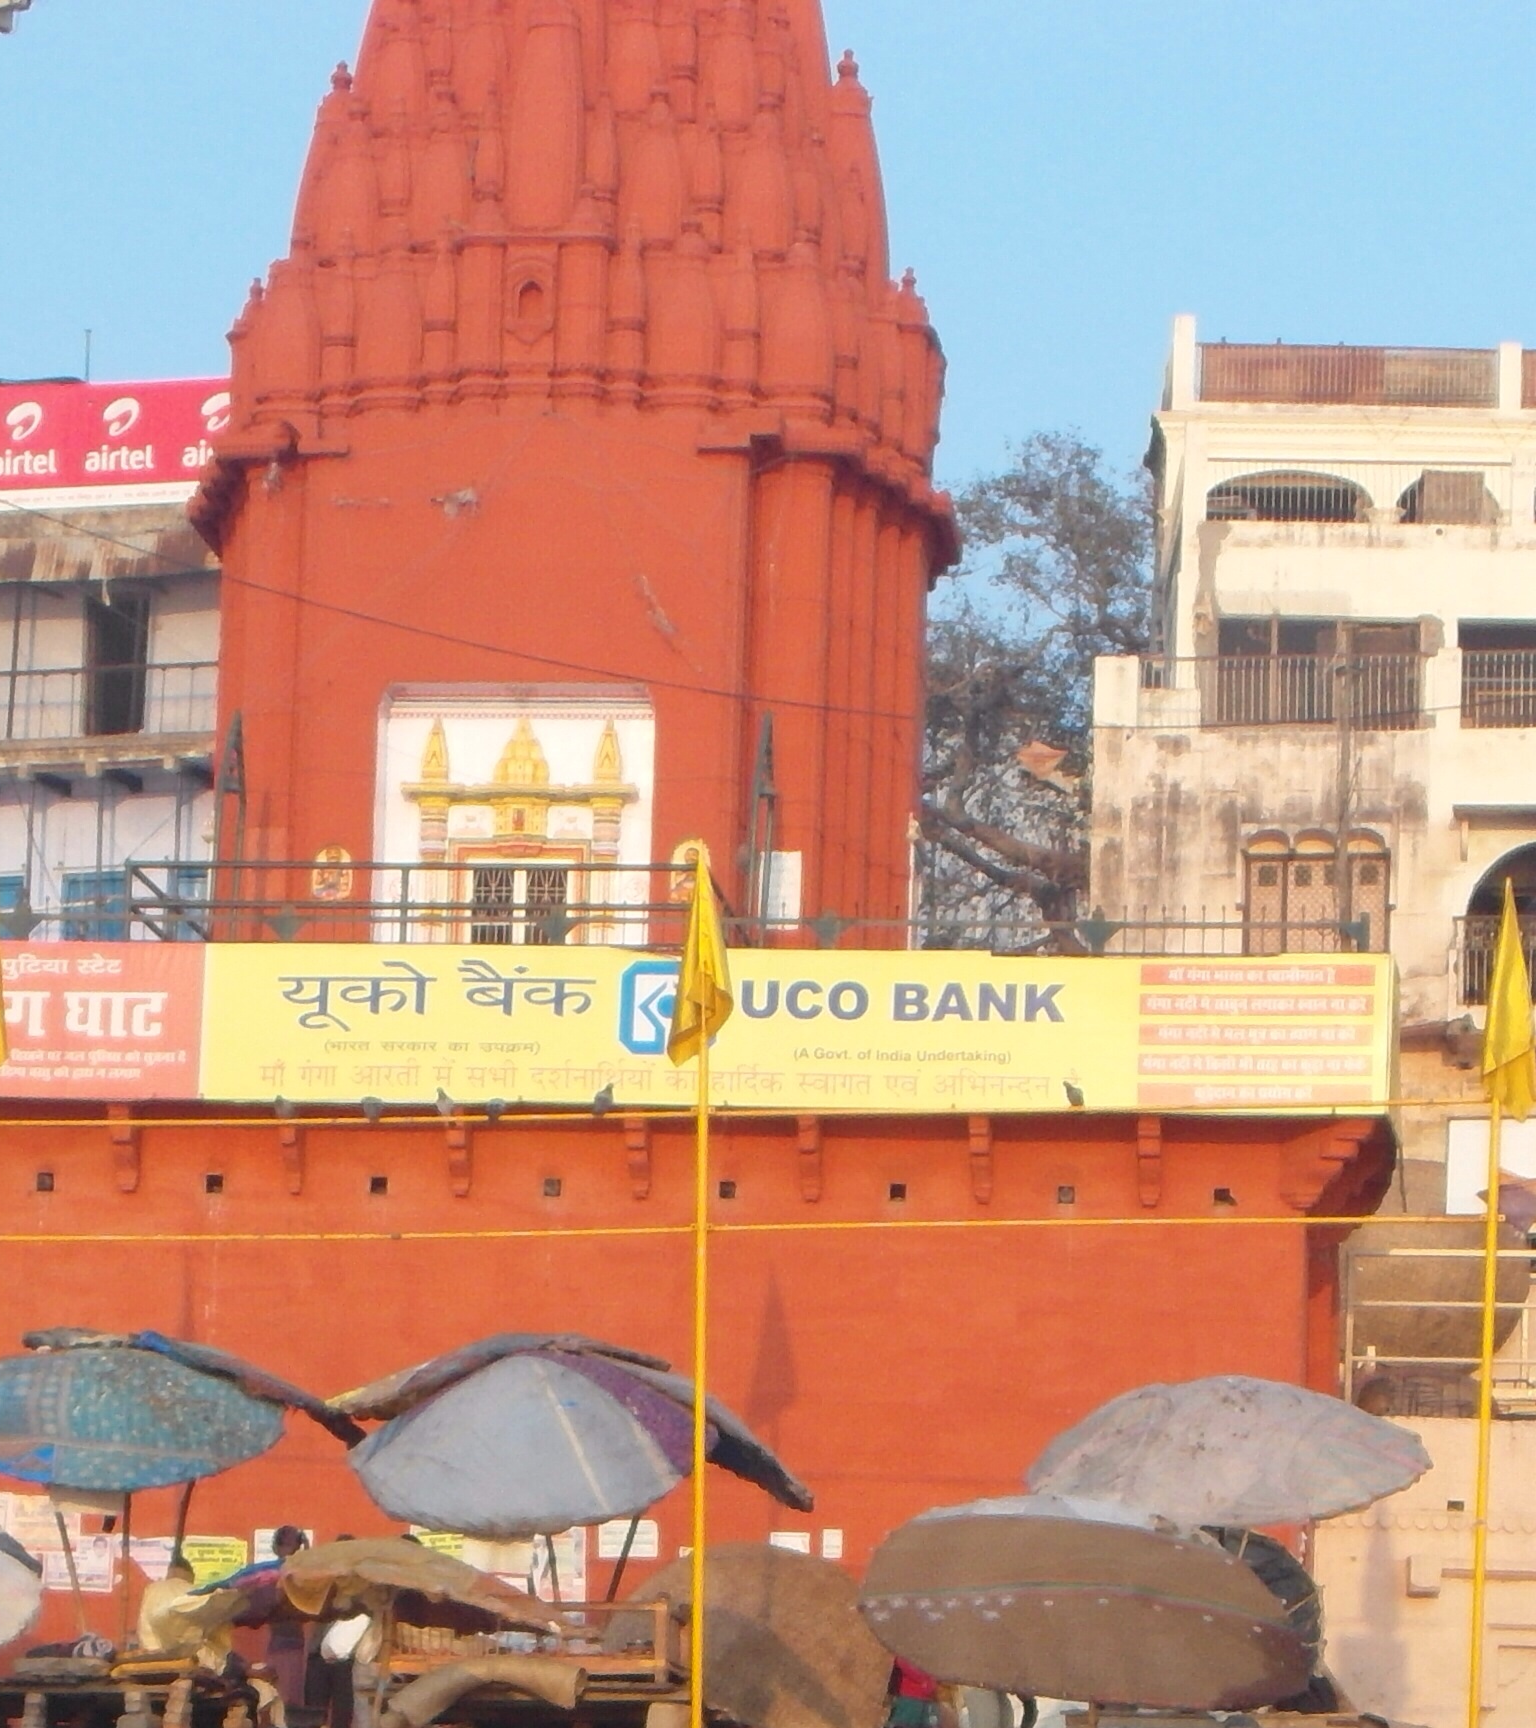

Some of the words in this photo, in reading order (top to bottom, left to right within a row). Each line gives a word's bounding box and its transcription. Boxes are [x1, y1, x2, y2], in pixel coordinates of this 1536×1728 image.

[85, 444, 154, 473] airtel
[77, 953, 122, 974] स्टेट
[278, 960, 437, 1032] यूको
[457, 959, 596, 1017] बैंक
[740, 979, 869, 1020] UCO
[892, 983, 1065, 1023] BANK
[64, 990, 167, 1038] घाट
[381, 1040, 437, 1053] सरकार
[448, 1041, 470, 1053] का
[480, 1041, 540, 1055] उपक्रम)
[793, 1048, 810, 1062] (A
[814, 1048, 852, 1061] Govt.
[857, 1048, 872, 1061] of
[875, 1048, 912, 1062] India
[916, 1049, 1012, 1065] Undertaking)
[299, 1059, 337, 1088] गंगा
[351, 1058, 420, 1088] आरती
[433, 1057, 456, 1087] में
[466, 1058, 517, 1089] सभी
[713, 1063, 784, 1094] हार्दिक
[796, 1070, 872, 1096] स्वागत
[933, 1067, 1050, 1098] अभिनन्दन
